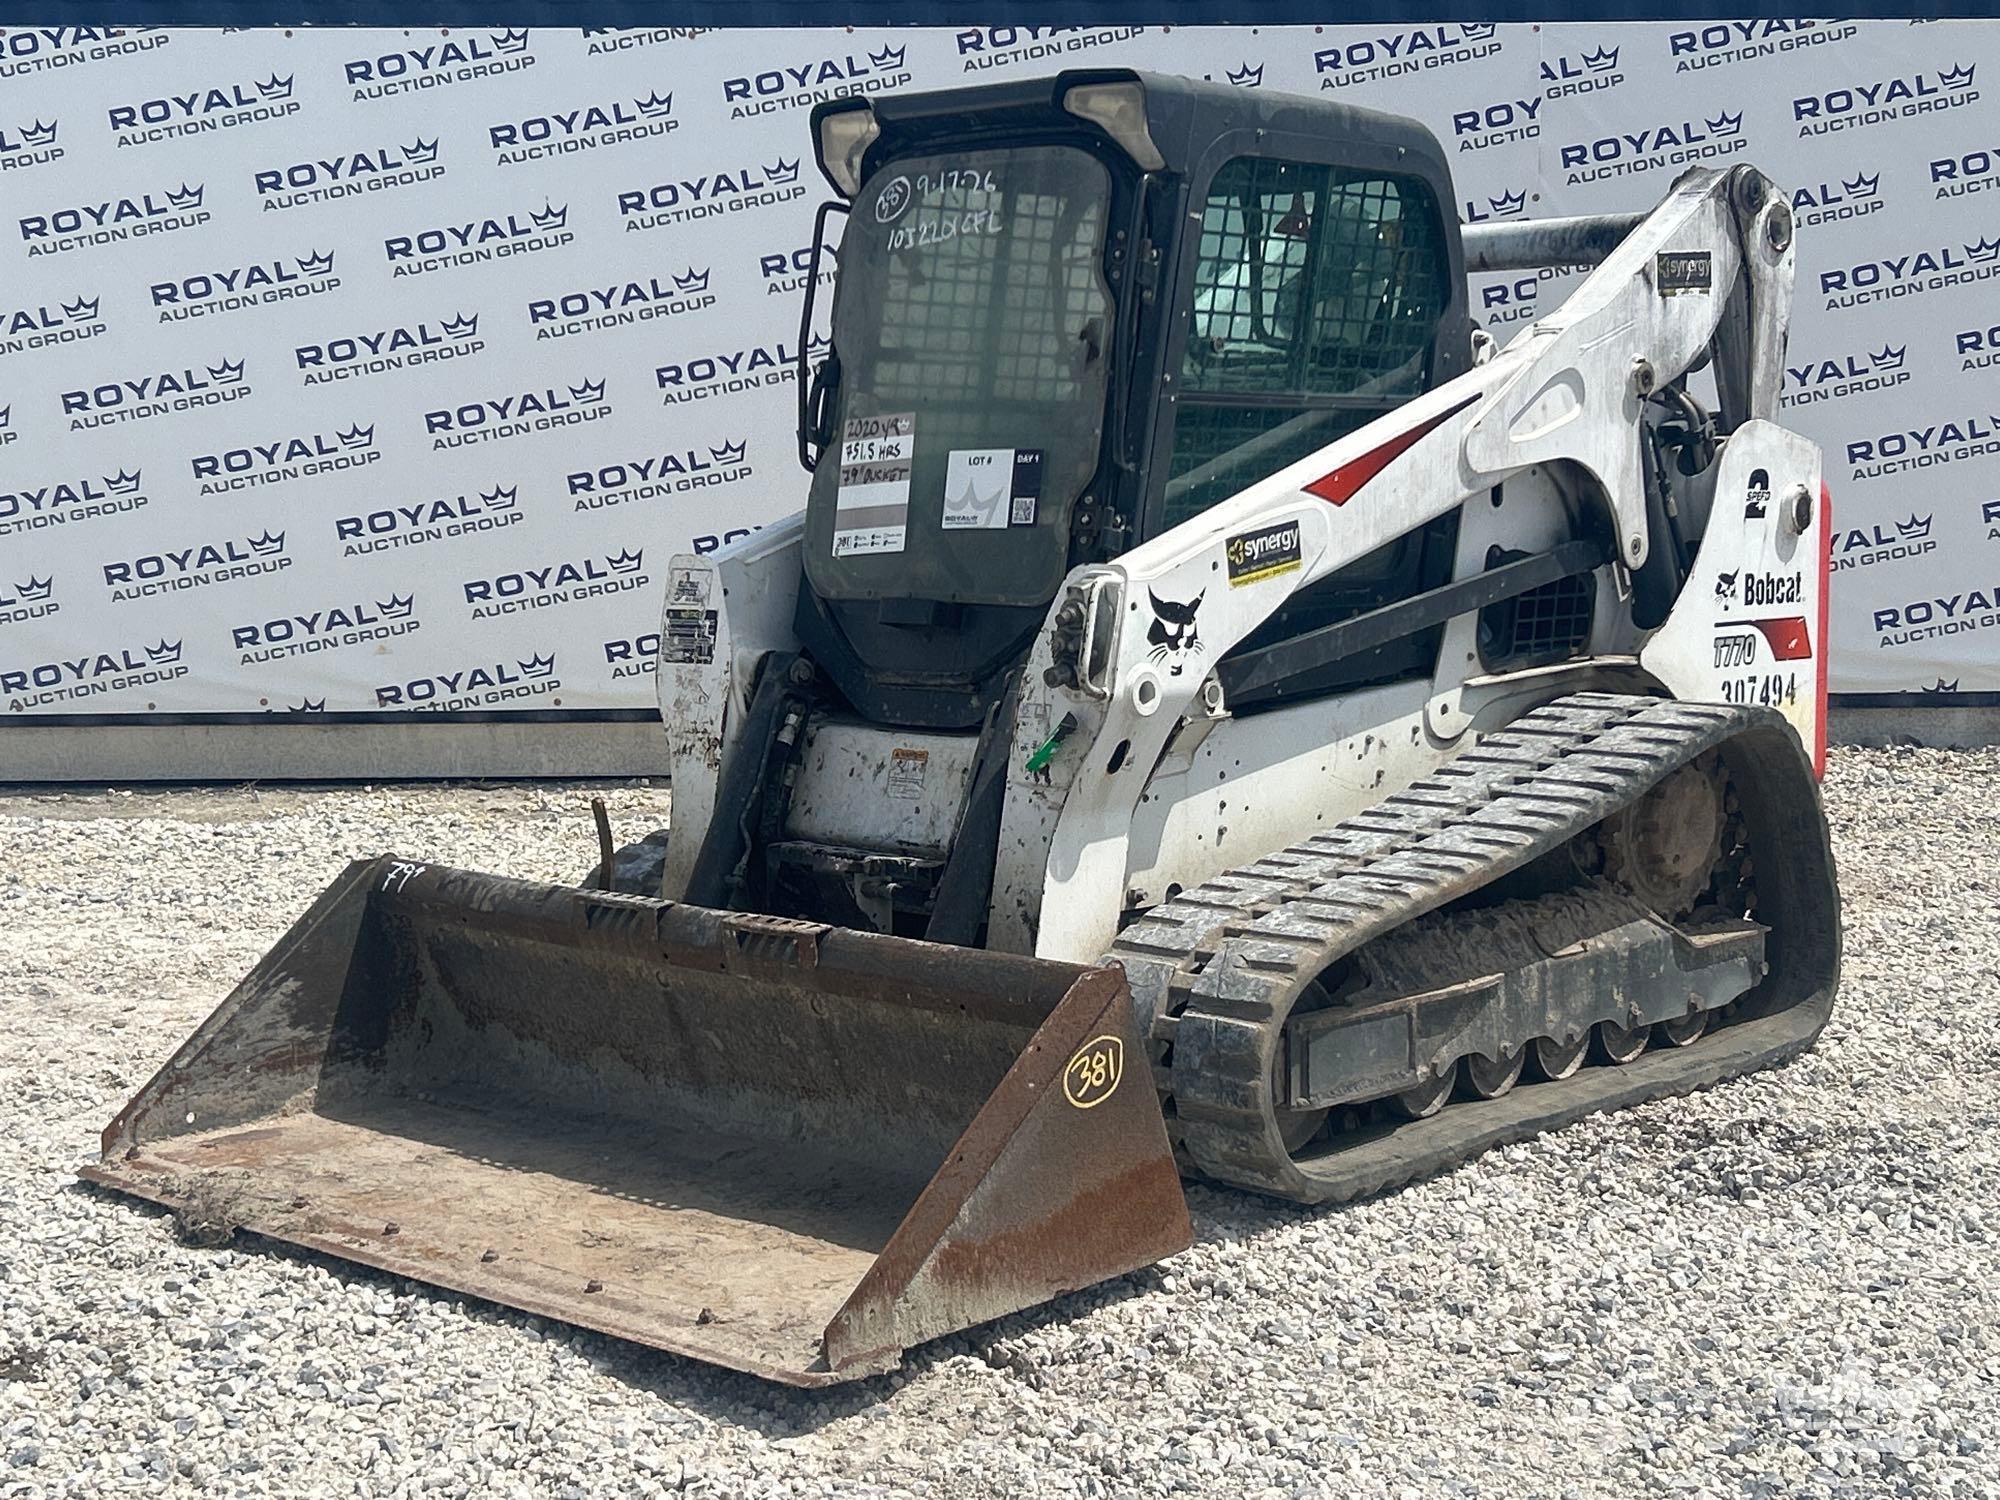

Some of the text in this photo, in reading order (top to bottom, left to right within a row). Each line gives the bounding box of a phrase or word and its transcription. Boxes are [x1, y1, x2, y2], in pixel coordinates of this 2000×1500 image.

[0, 27, 126, 60] OYAL
[0, 35, 169, 77] UCTION GROUP
[345, 39, 493, 85] ROYAL
[588, 28, 686, 55] AUCTION
[964, 27, 1144, 73] AUCTION GROUP
[1314, 27, 1460, 73] ROYAL
[1676, 26, 1857, 73] AUCTION GROUP
[353, 56, 535, 102] AUCTION GROUP
[724, 56, 870, 102] ROYAL
[1321, 43, 1502, 90] AUCTION GROUP
[1546, 74, 1624, 99] GROUP
[109, 85, 257, 130] ROYAL
[731, 73, 911, 119] AUCTION GROUP
[1453, 97, 1541, 135] ROY
[1793, 75, 1938, 121] ROYAL
[1799, 91, 1979, 138] AUCTION GROUP
[118, 102, 300, 148] AUCTION GROUP
[489, 103, 636, 148] ROYAL
[498, 120, 679, 166] AUCTION GROUP
[1460, 125, 1540, 152] AUCTIO
[1561, 123, 1706, 169] ROYAL
[0, 148, 64, 170] ROUP
[255, 149, 403, 194] ROYAL
[1567, 139, 1747, 185] AUCTION GROUP
[263, 166, 445, 212] AUCTION GROUP
[618, 170, 764, 215] ROYAL
[626, 186, 806, 232] AUCTION GROUP
[1936, 176, 2000, 200] AUCTI
[19, 195, 168, 240] ROYAL
[28, 212, 210, 257] AUCTION GROUP
[1807, 200, 1884, 226] GROUP
[385, 215, 532, 261] ROYAL
[394, 232, 574, 278] AUCTION GROUP
[151, 262, 298, 306] ROYAL
[1820, 249, 1964, 294] ROYAL
[1826, 265, 2000, 311] AUCTION GROUP
[159, 278, 340, 323] AUCTION GROUP
[529, 279, 674, 324] ROYAL
[537, 295, 716, 341] AUCTION GROUP
[28, 324, 106, 348] GROUP
[295, 324, 442, 369] ROYAL
[304, 341, 484, 386] AUCTION GROUP
[656, 344, 799, 389] ROYAL
[1780, 356, 1869, 390] YAL
[61, 370, 209, 414] ROYAL
[70, 386, 251, 431] AUCTION GROUP
[425, 390, 570, 434] ROYAL
[664, 376, 760, 405] AUCTION
[1778, 372, 1910, 408] TION GROUP
[433, 406, 612, 451] AUCTION GROUP
[1847, 419, 1990, 464] ROYAL
[192, 435, 338, 479] ROYAL
[567, 451, 711, 495] ROYAL
[878, 442, 901, 460] HRS
[969, 456, 985, 466] LOT
[1017, 454, 1033, 463] DAY
[1853, 441, 2000, 481] AUCTION GRO
[200, 451, 380, 496] AUCTION GROUP
[575, 467, 752, 512] AUCTION GROUP
[0, 480, 105, 518] OYAL
[0, 497, 148, 535] CTION GROUP
[336, 496, 482, 540] ROYAL
[344, 512, 523, 557] AUCTION GROUP
[1244, 528, 1299, 560] synergy
[1860, 541, 1936, 565] GROUP
[103, 541, 250, 585] ROYAL
[112, 558, 292, 602] AUCTION GROUP
[464, 559, 608, 603] ROYAL
[472, 591, 569, 620] AUCTION
[573, 576, 649, 599] GROUP
[1744, 572, 1802, 606] Bobcat
[0, 603, 59, 625] ROUP
[232, 605, 378, 649] ROYAL
[1880, 619, 1976, 648] AUCTION
[241, 621, 420, 665] AUCTION GROUP
[1713, 634, 1756, 668] T770
[0, 650, 146, 694] ROYAL
[9, 666, 188, 711] AUCTION GROUP
[375, 664, 519, 708] ROYAL
[485, 680, 560, 703] GROUP
[1721, 672, 1796, 707] 307494
[1070, 1047, 1115, 1098] 381
